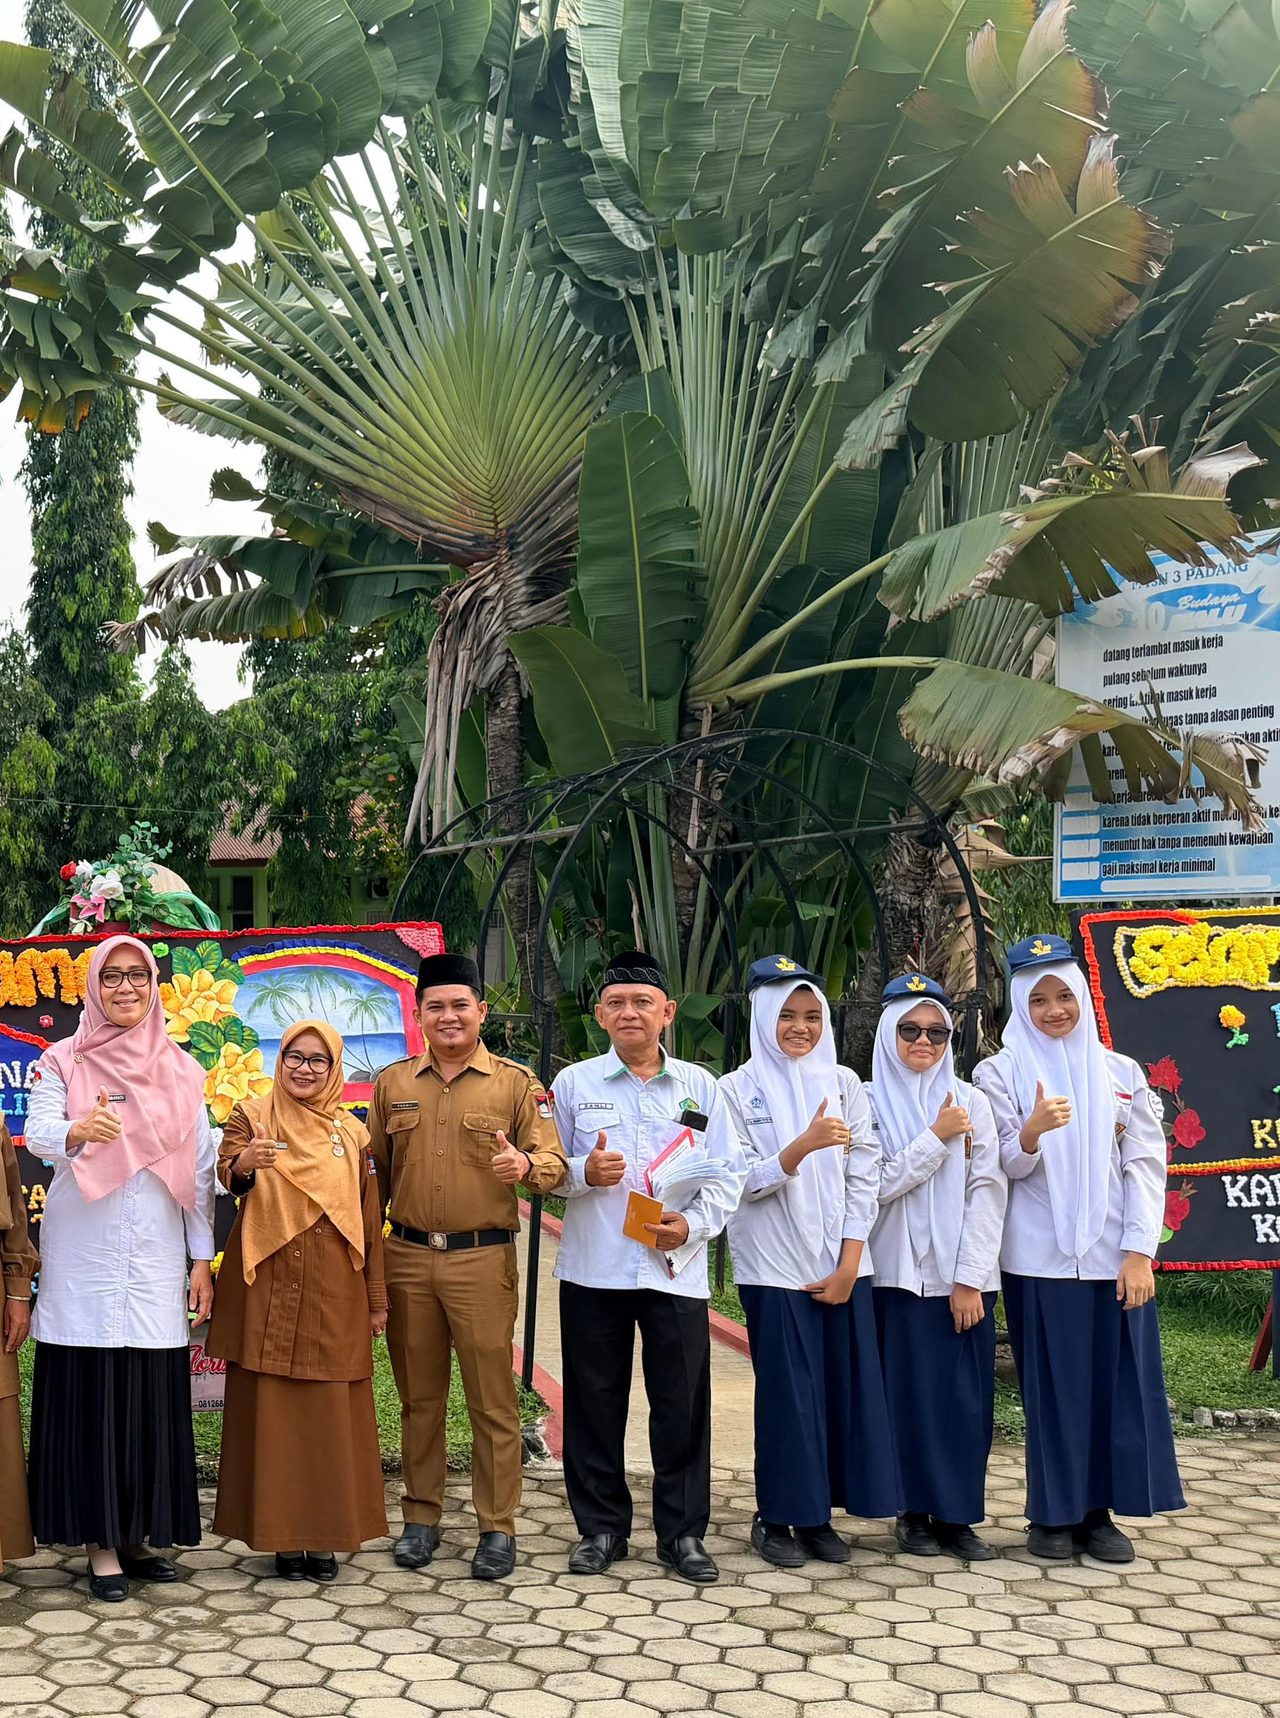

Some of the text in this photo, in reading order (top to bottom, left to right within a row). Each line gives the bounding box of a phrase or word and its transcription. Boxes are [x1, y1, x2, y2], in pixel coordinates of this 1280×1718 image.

[1173, 570, 1181, 583] 3
[1178, 592, 1241, 611] Budaya
[1103, 633, 1224, 663] datang terlambat masuk kerja
[1103, 671, 1130, 687] pulang
[1168, 662, 1207, 679] waktunya
[1166, 686, 1194, 703] masuk
[1195, 684, 1217, 701] kerja
[1163, 713, 1183, 728] ugas
[1185, 711, 1209, 726] tanpa
[1210, 708, 1239, 724] alasan
[1241, 704, 1275, 721] penting
[1102, 814, 1130, 829] karena
[1131, 812, 1151, 827] tidak
[1153, 811, 1190, 827] berperan
[1192, 808, 1211, 823] aktif
[1102, 837, 1140, 852] menuntut
[1141, 834, 1156, 850] hak
[1158, 835, 1181, 851] tanpa
[1183, 831, 1227, 848] memenuhi
[1102, 857, 1216, 877] gaji maksimal kerja minimal
